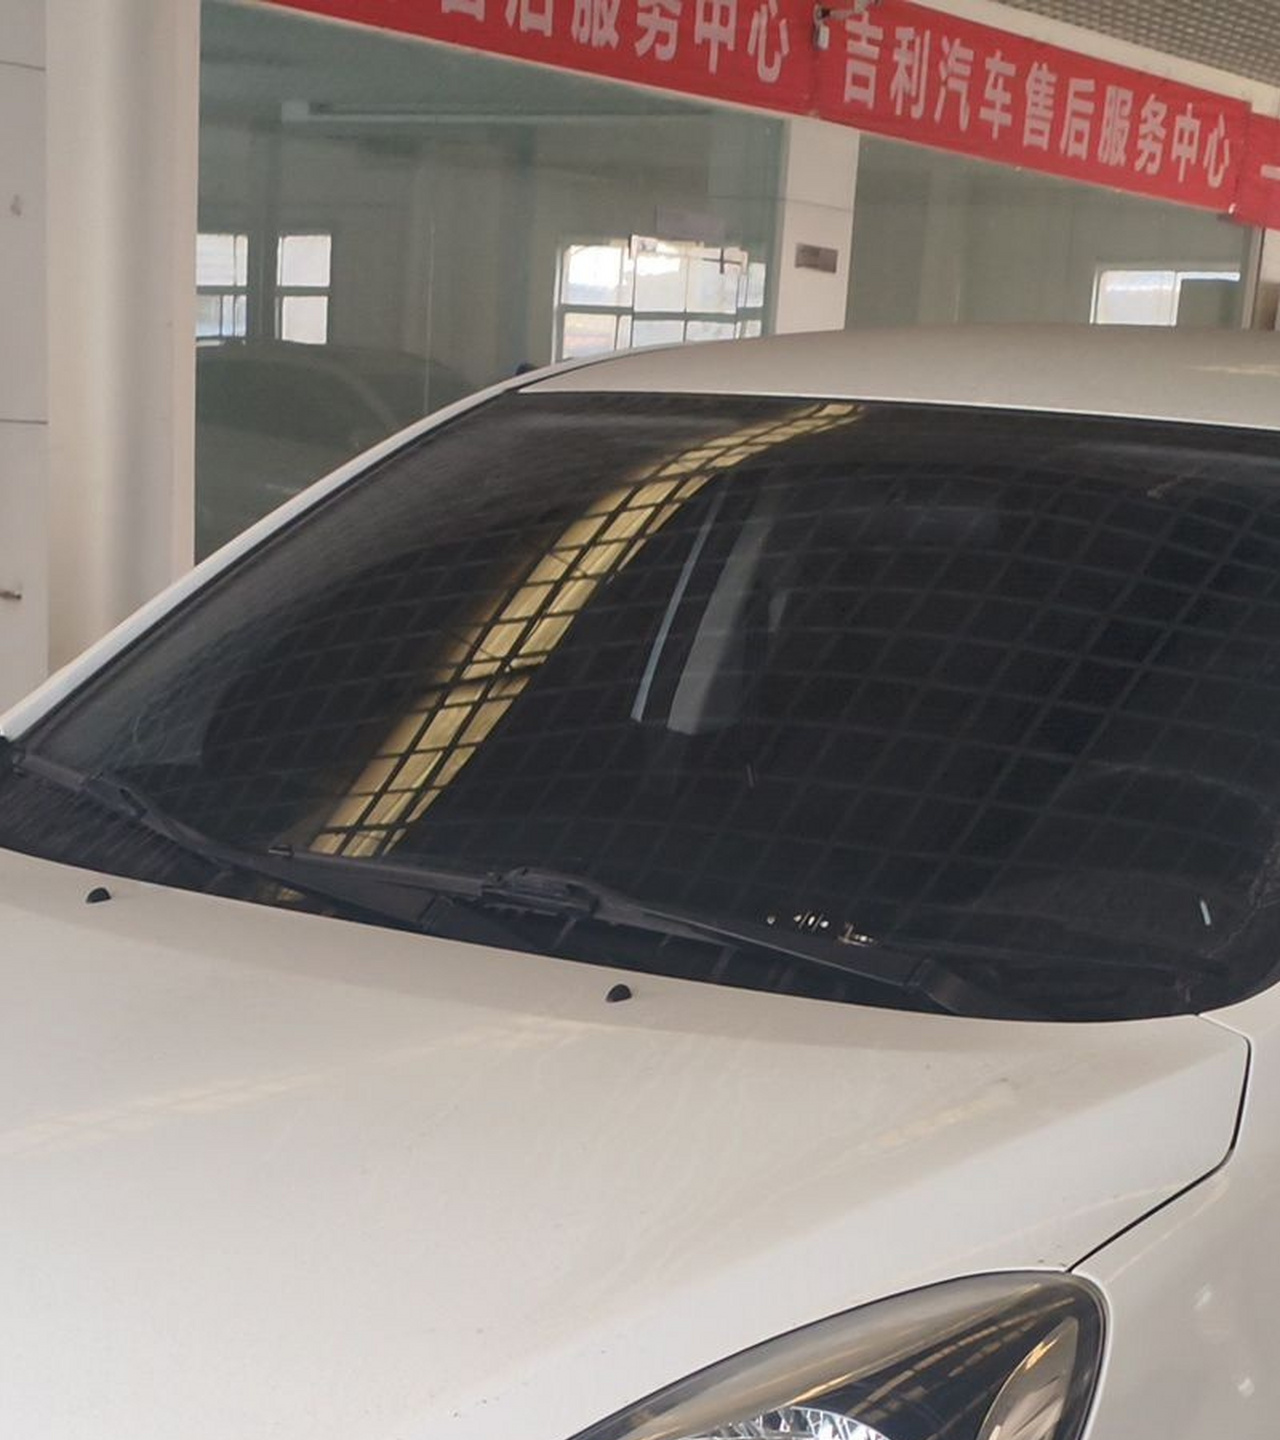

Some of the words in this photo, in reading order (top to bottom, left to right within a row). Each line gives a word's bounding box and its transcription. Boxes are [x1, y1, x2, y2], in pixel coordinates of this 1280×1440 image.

[441, 0, 790, 83] 服务中心
[844, 11, 1230, 188] 吉利汽车售后服务中心
